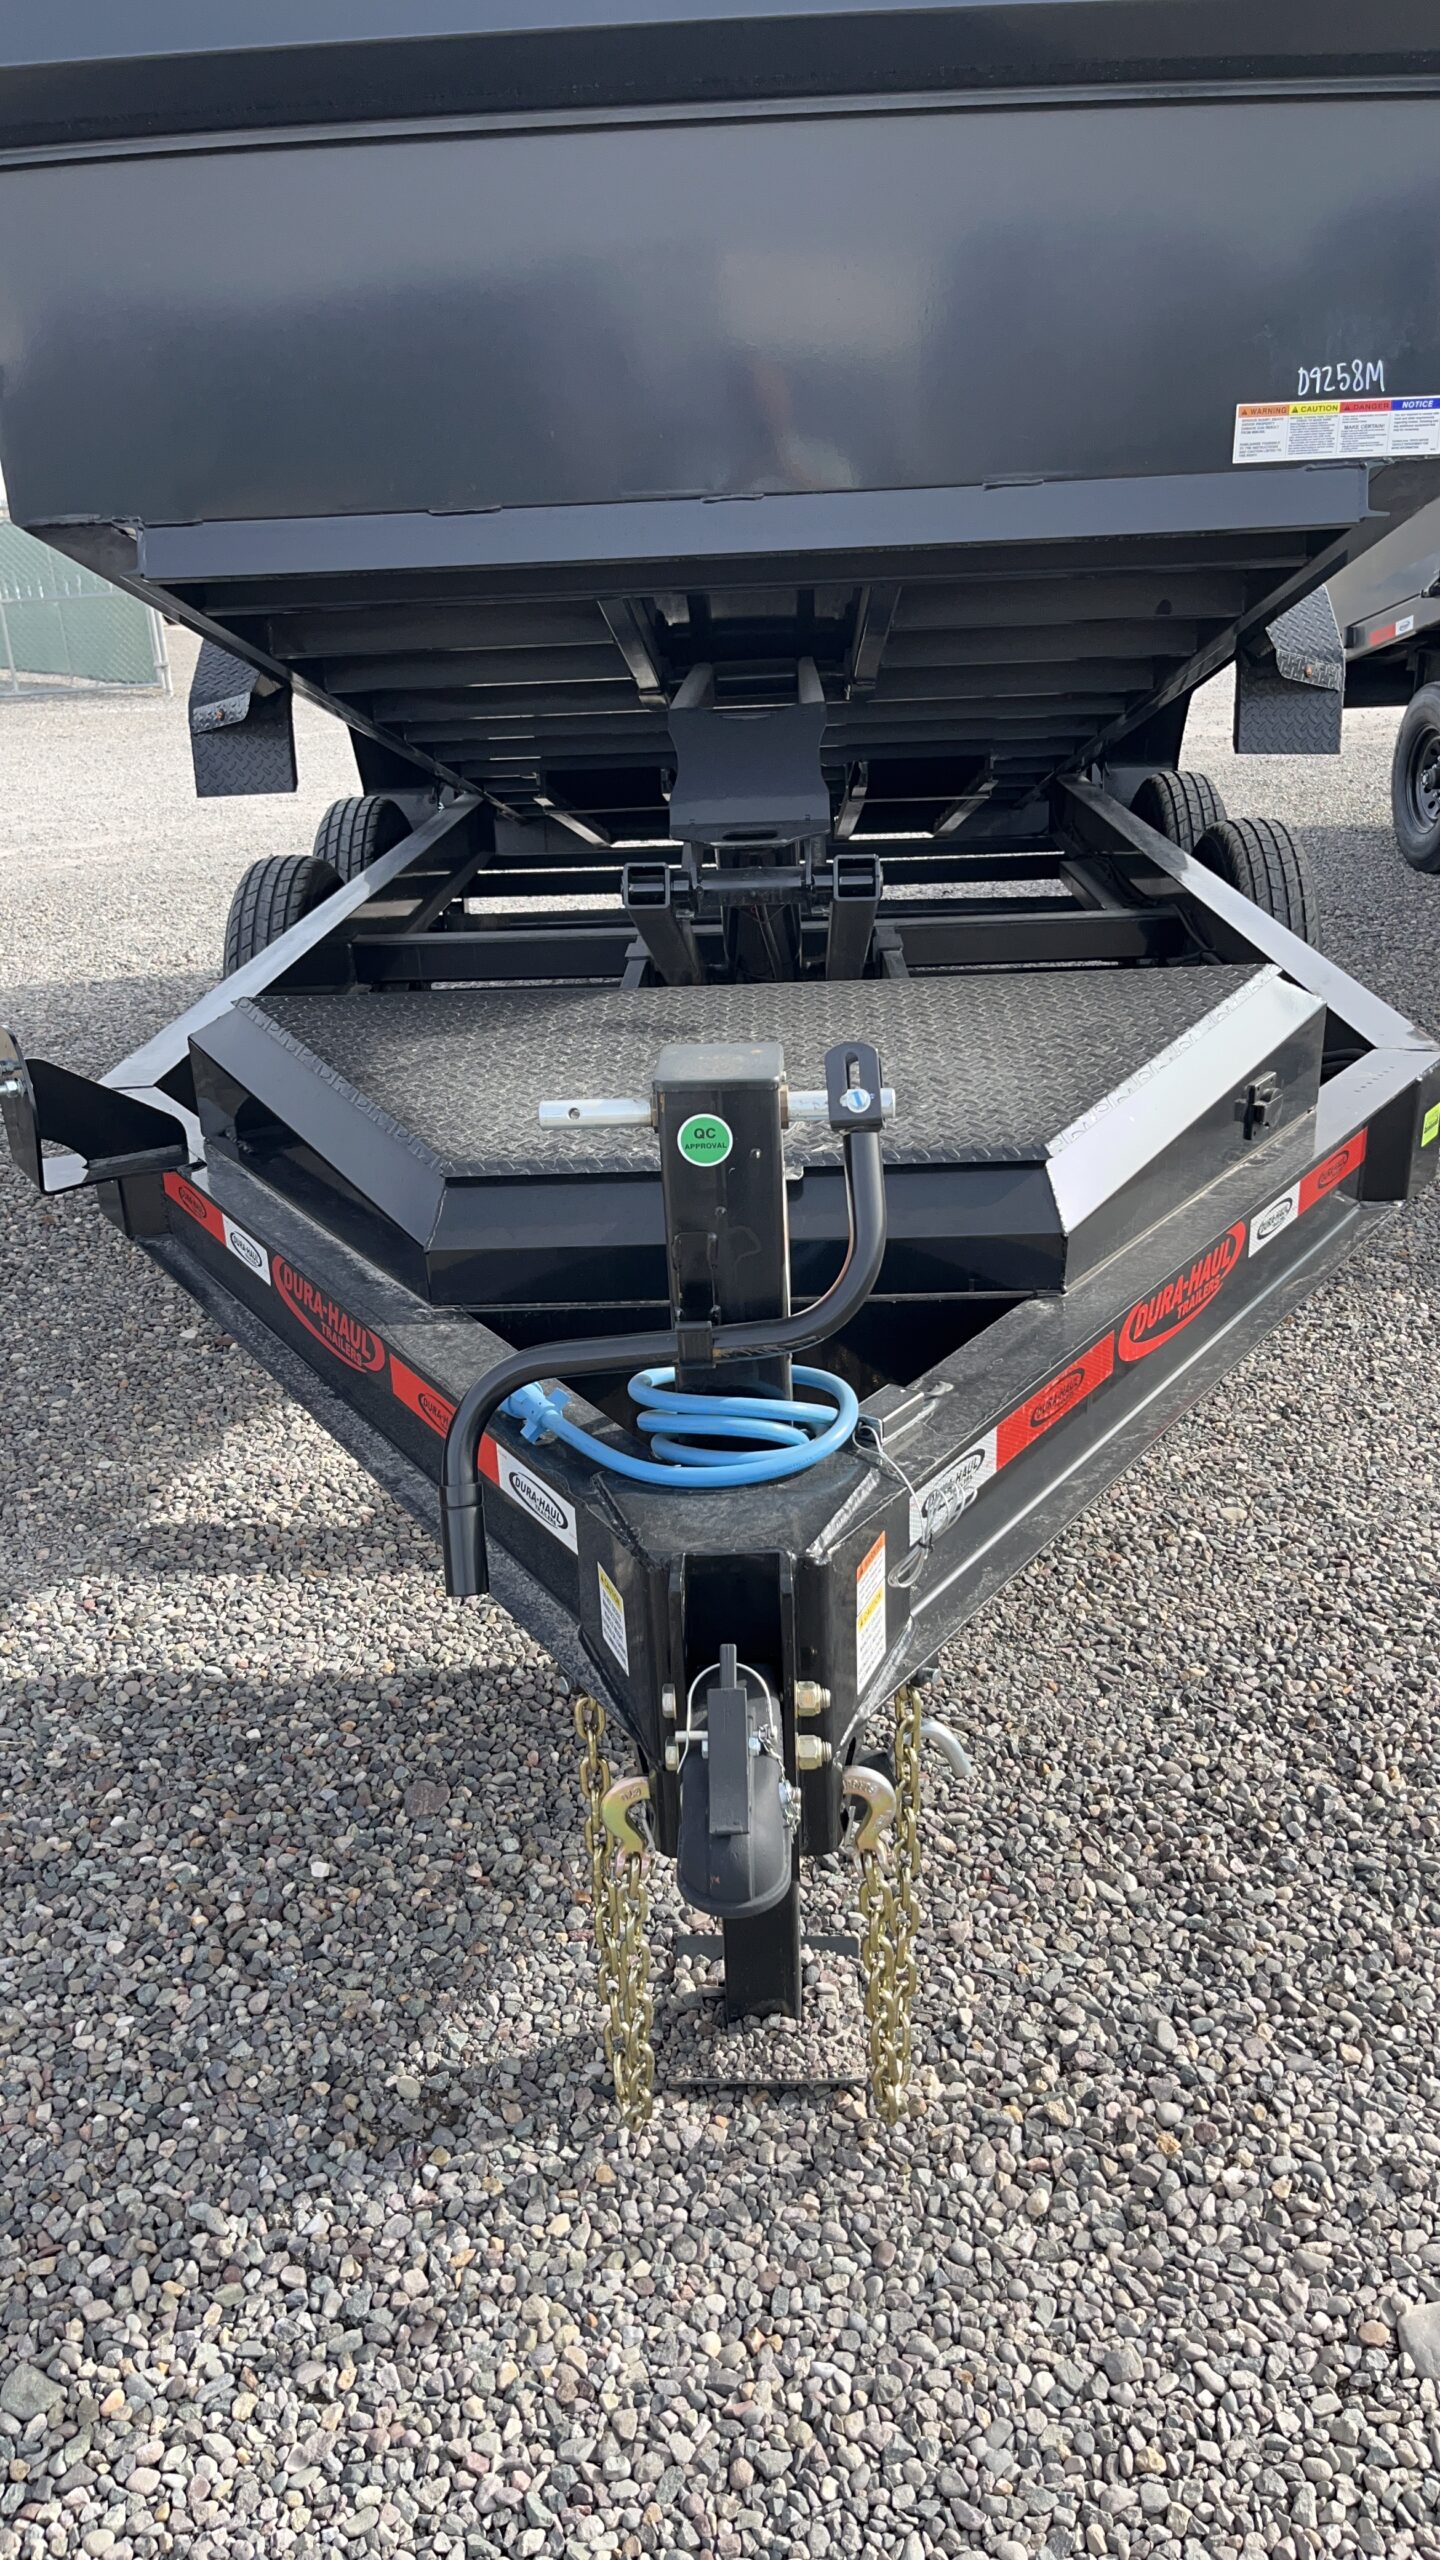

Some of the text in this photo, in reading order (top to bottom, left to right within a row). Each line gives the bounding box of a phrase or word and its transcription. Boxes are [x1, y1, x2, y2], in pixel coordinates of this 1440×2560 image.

[1298, 359, 1386, 396] D9258M
[1250, 406, 1287, 415] WARNING
[1300, 404, 1338, 413] CAUTION
[1353, 402, 1389, 410] DANGER
[1402, 400, 1434, 409] NOTICE
[694, 1127, 716, 1139] QC
[684, 1142, 727, 1150] APPROVAL
[1133, 1238, 1232, 1341] DURA-HAUL
[1177, 1275, 1224, 1319] TRAILERS
[283, 1264, 371, 1360] DURA-HAUL
[321, 1321, 362, 1367] TRAILERS
[514, 1476, 562, 1525] DURA-HAUL
